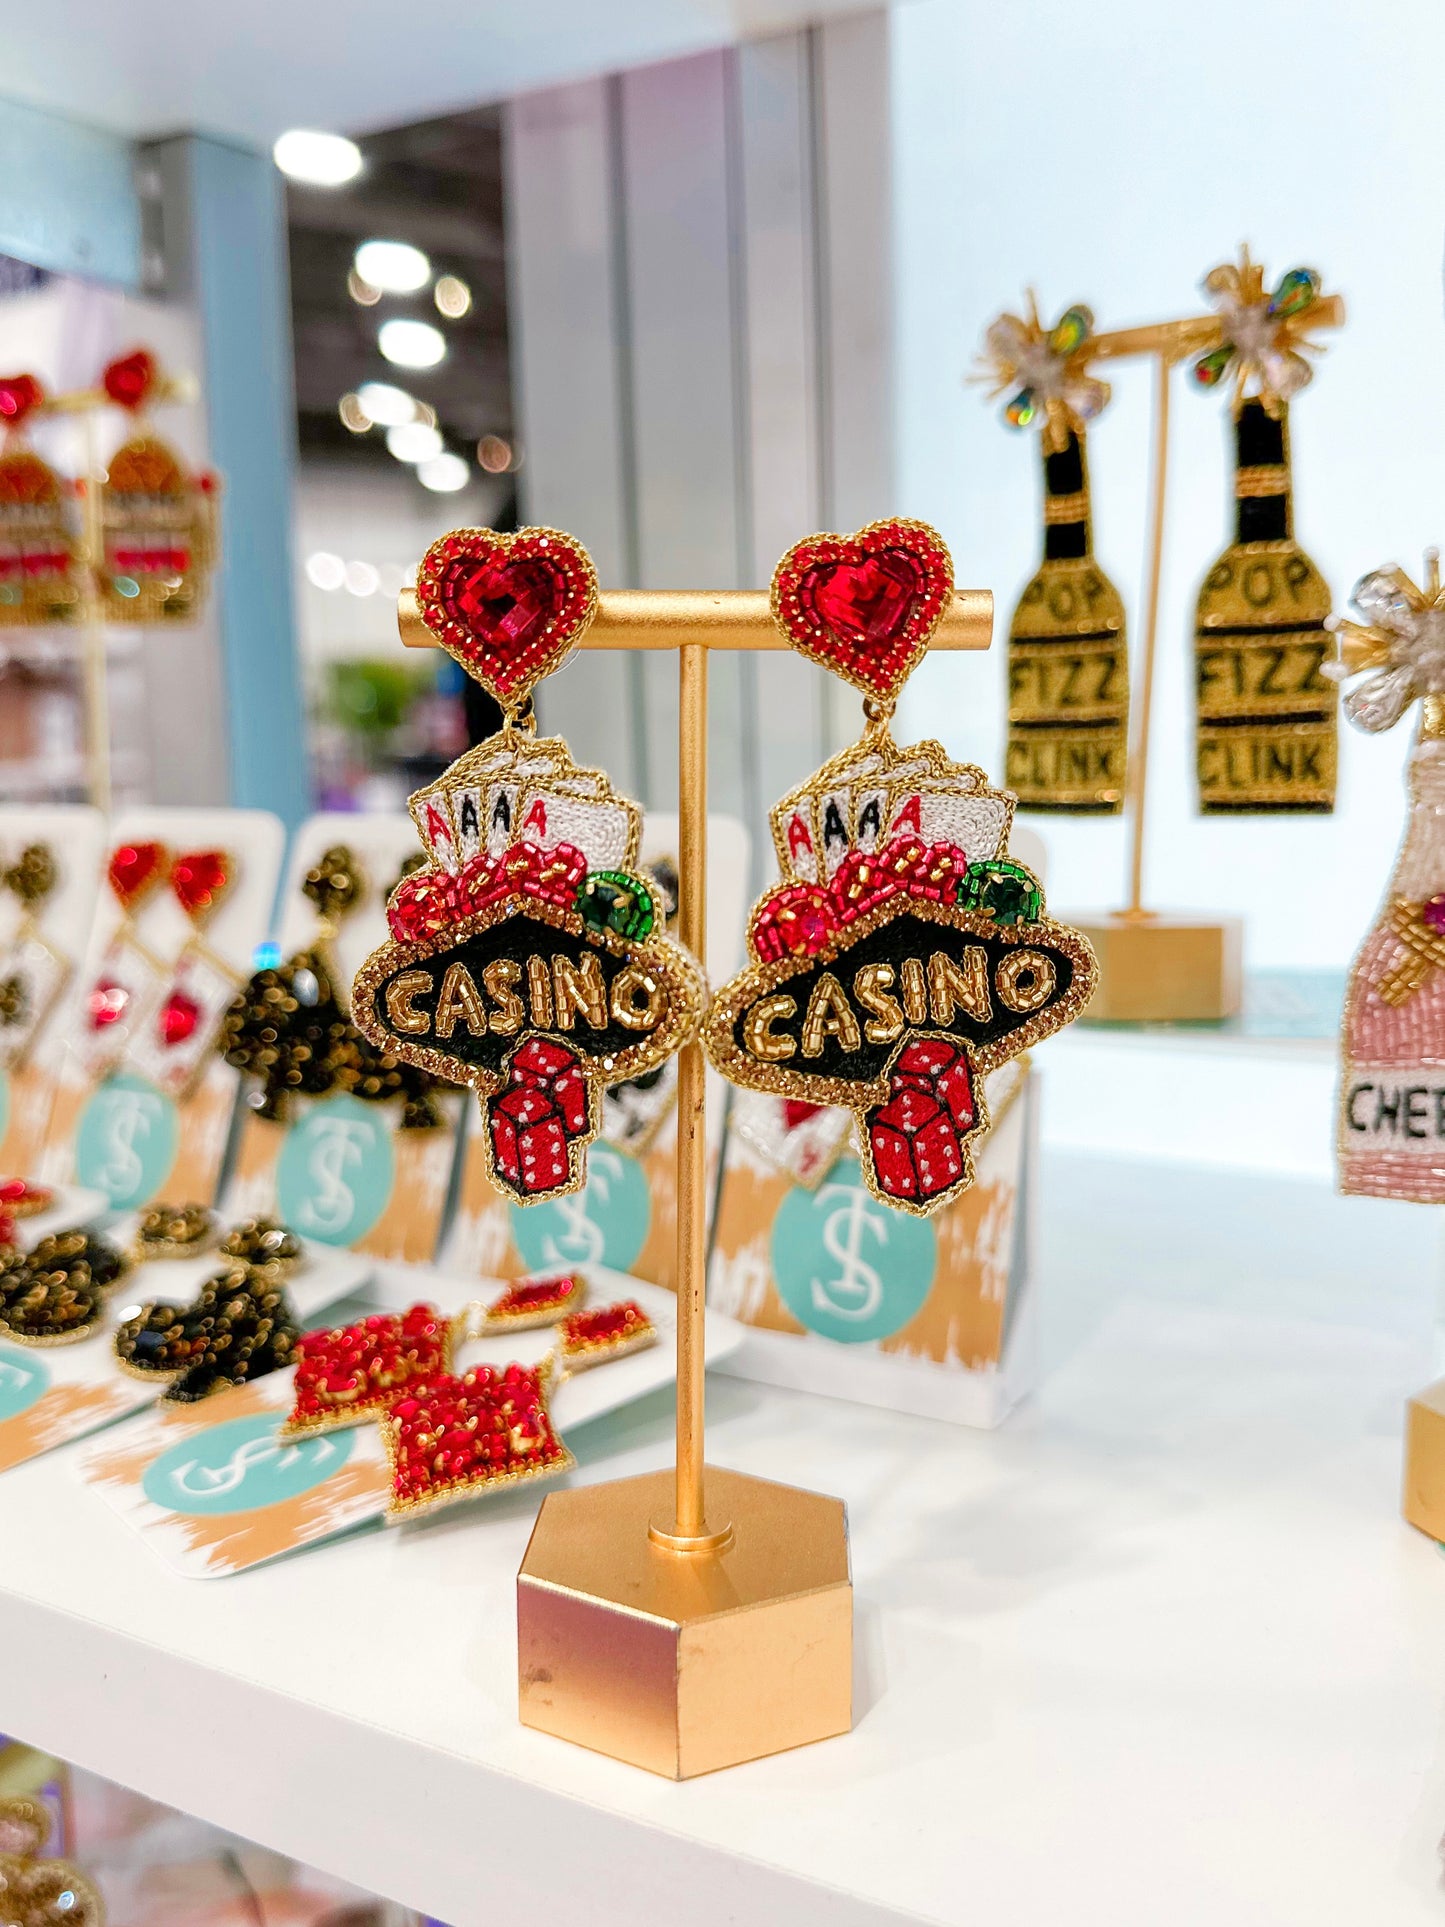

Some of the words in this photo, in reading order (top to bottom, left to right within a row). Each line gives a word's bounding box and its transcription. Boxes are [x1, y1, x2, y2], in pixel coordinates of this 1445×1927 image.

[1022, 569, 1104, 622] POP
[1207, 556, 1311, 608] POP
[1009, 655, 1117, 706] FIZZ
[1200, 643, 1330, 699] FIZZ
[1200, 739, 1321, 788] CLINK
[427, 801, 451, 846] A
[462, 794, 480, 836] A
[493, 789, 510, 833] A
[523, 799, 547, 839] A
[787, 813, 812, 859] A
[824, 803, 848, 848] A
[858, 799, 881, 840] A
[891, 795, 921, 834] A
[385, 950, 669, 1038] CASINO
[743, 945, 1057, 1062] CASINO
